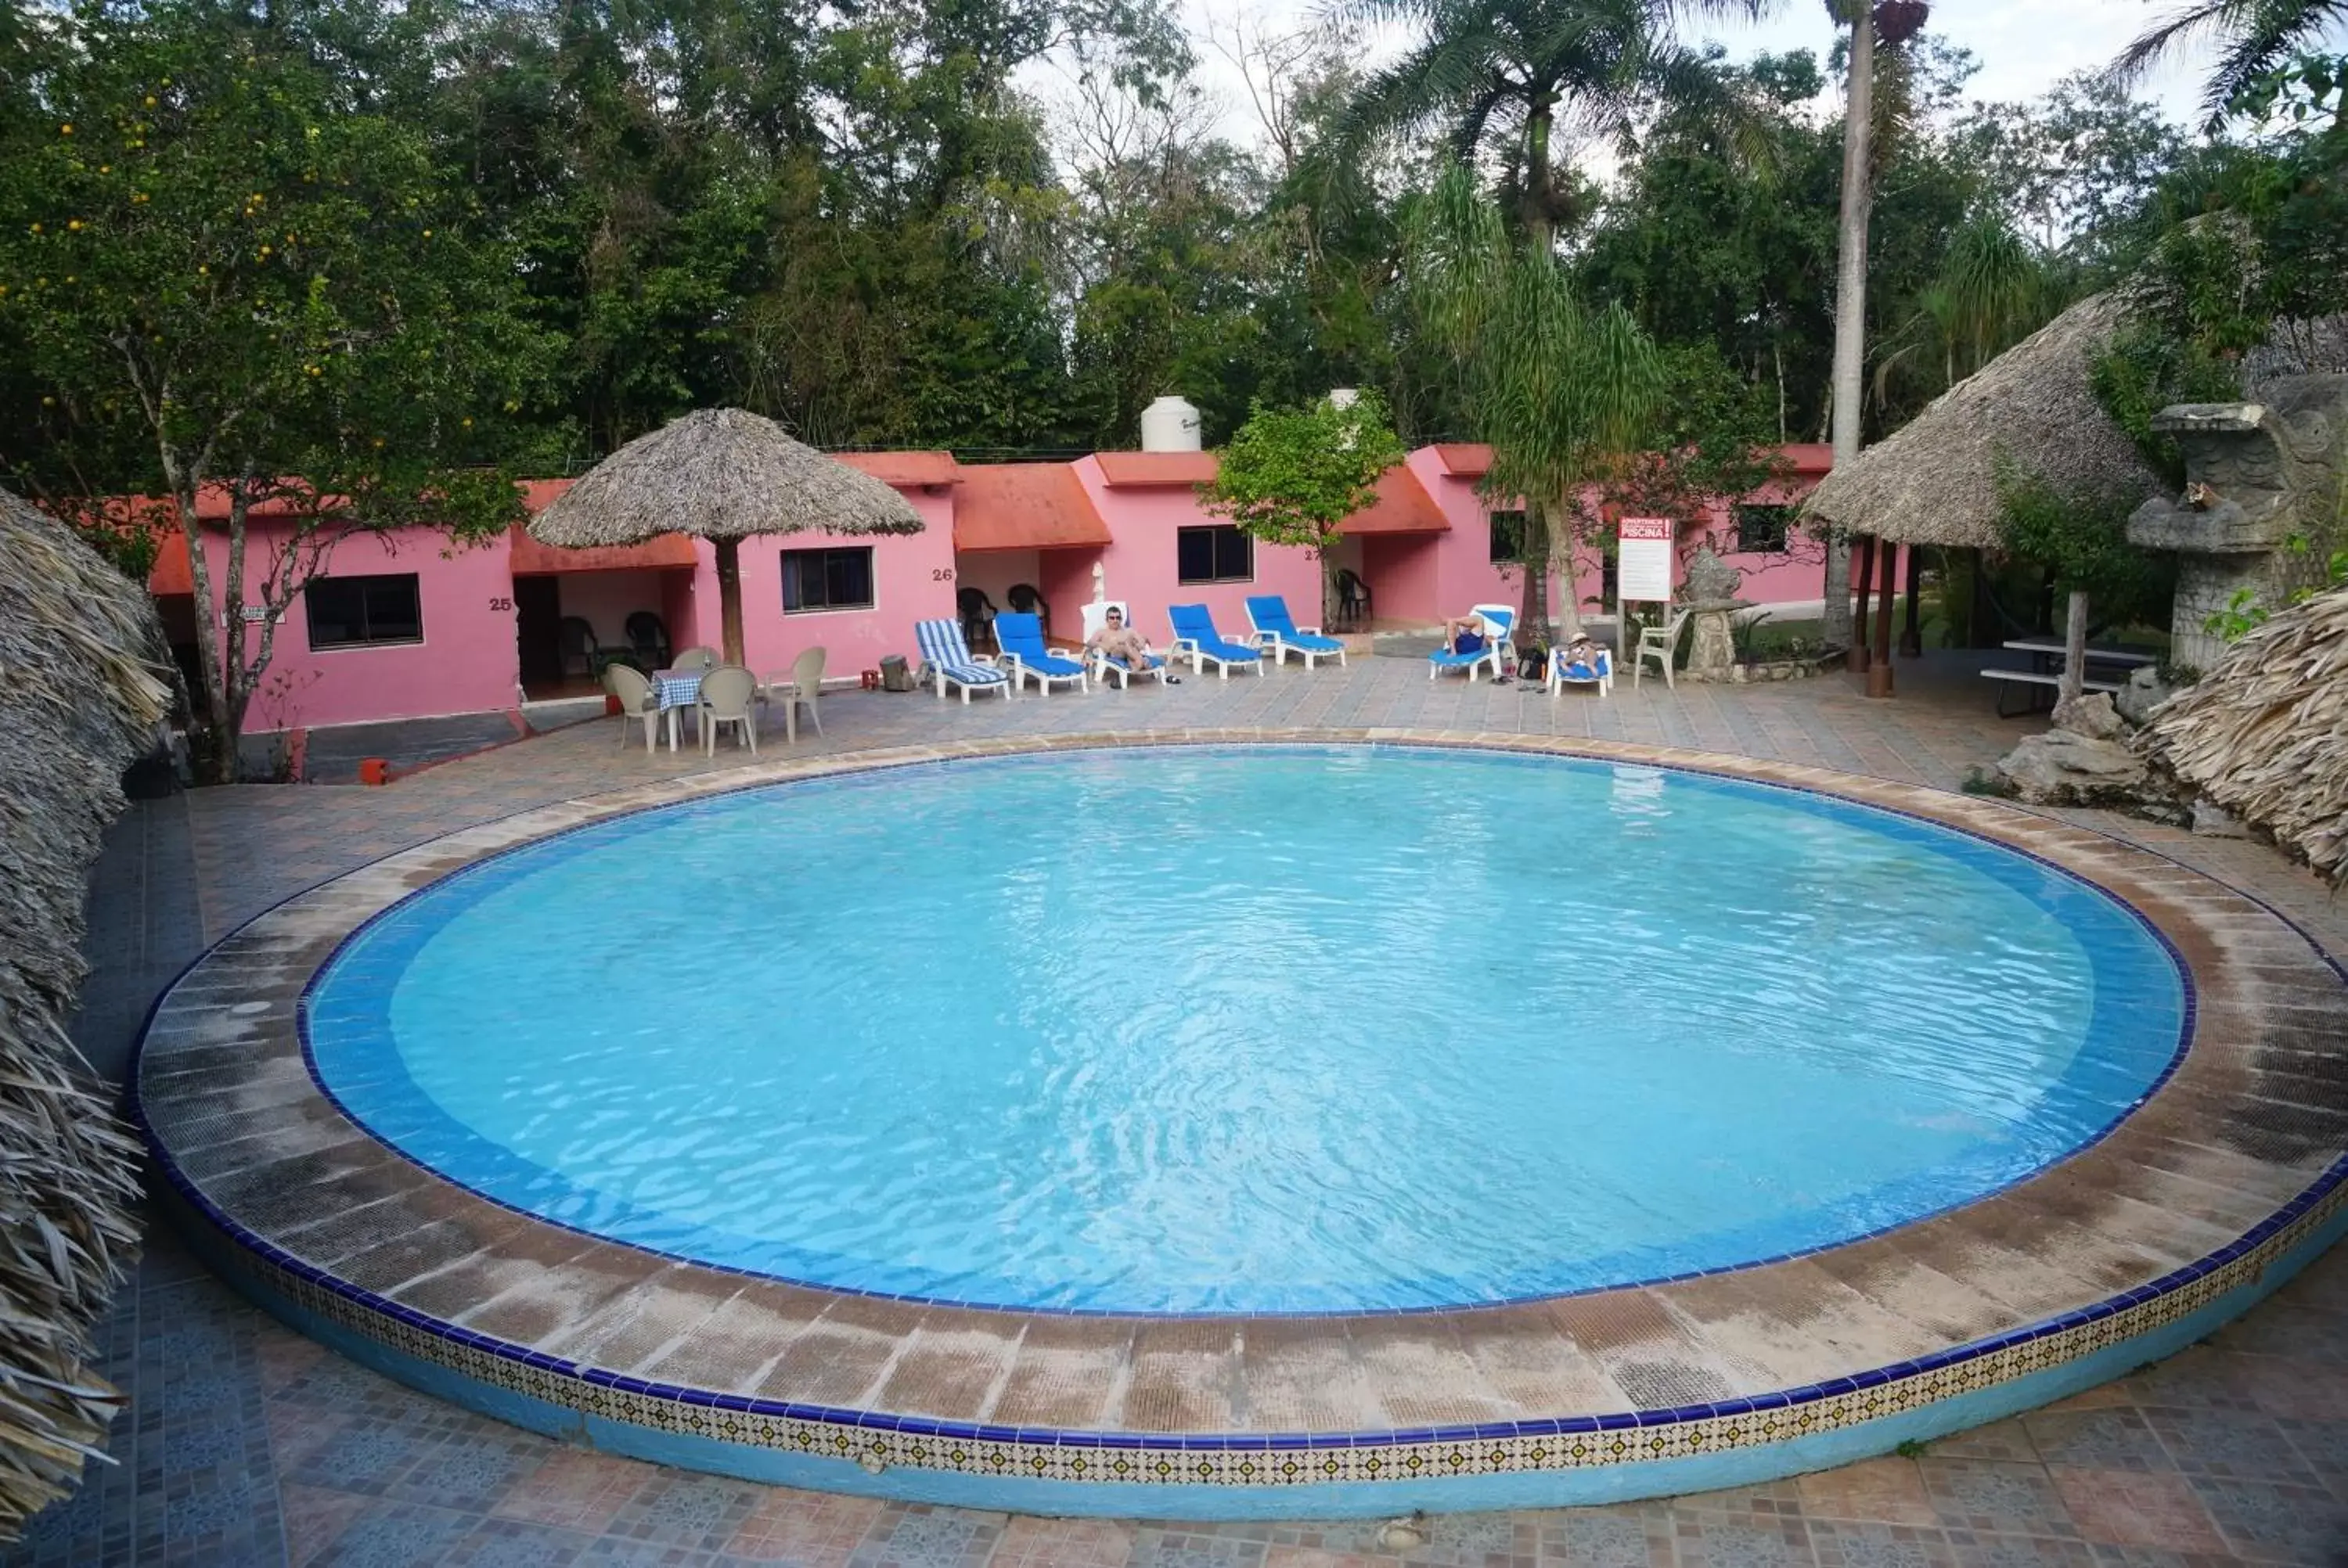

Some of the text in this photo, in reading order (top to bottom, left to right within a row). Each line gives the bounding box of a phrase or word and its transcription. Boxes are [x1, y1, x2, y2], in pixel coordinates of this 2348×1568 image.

[1621, 527, 1663, 538] PISCINA
[932, 568, 953, 581] 26
[489, 598, 512, 610] 25
